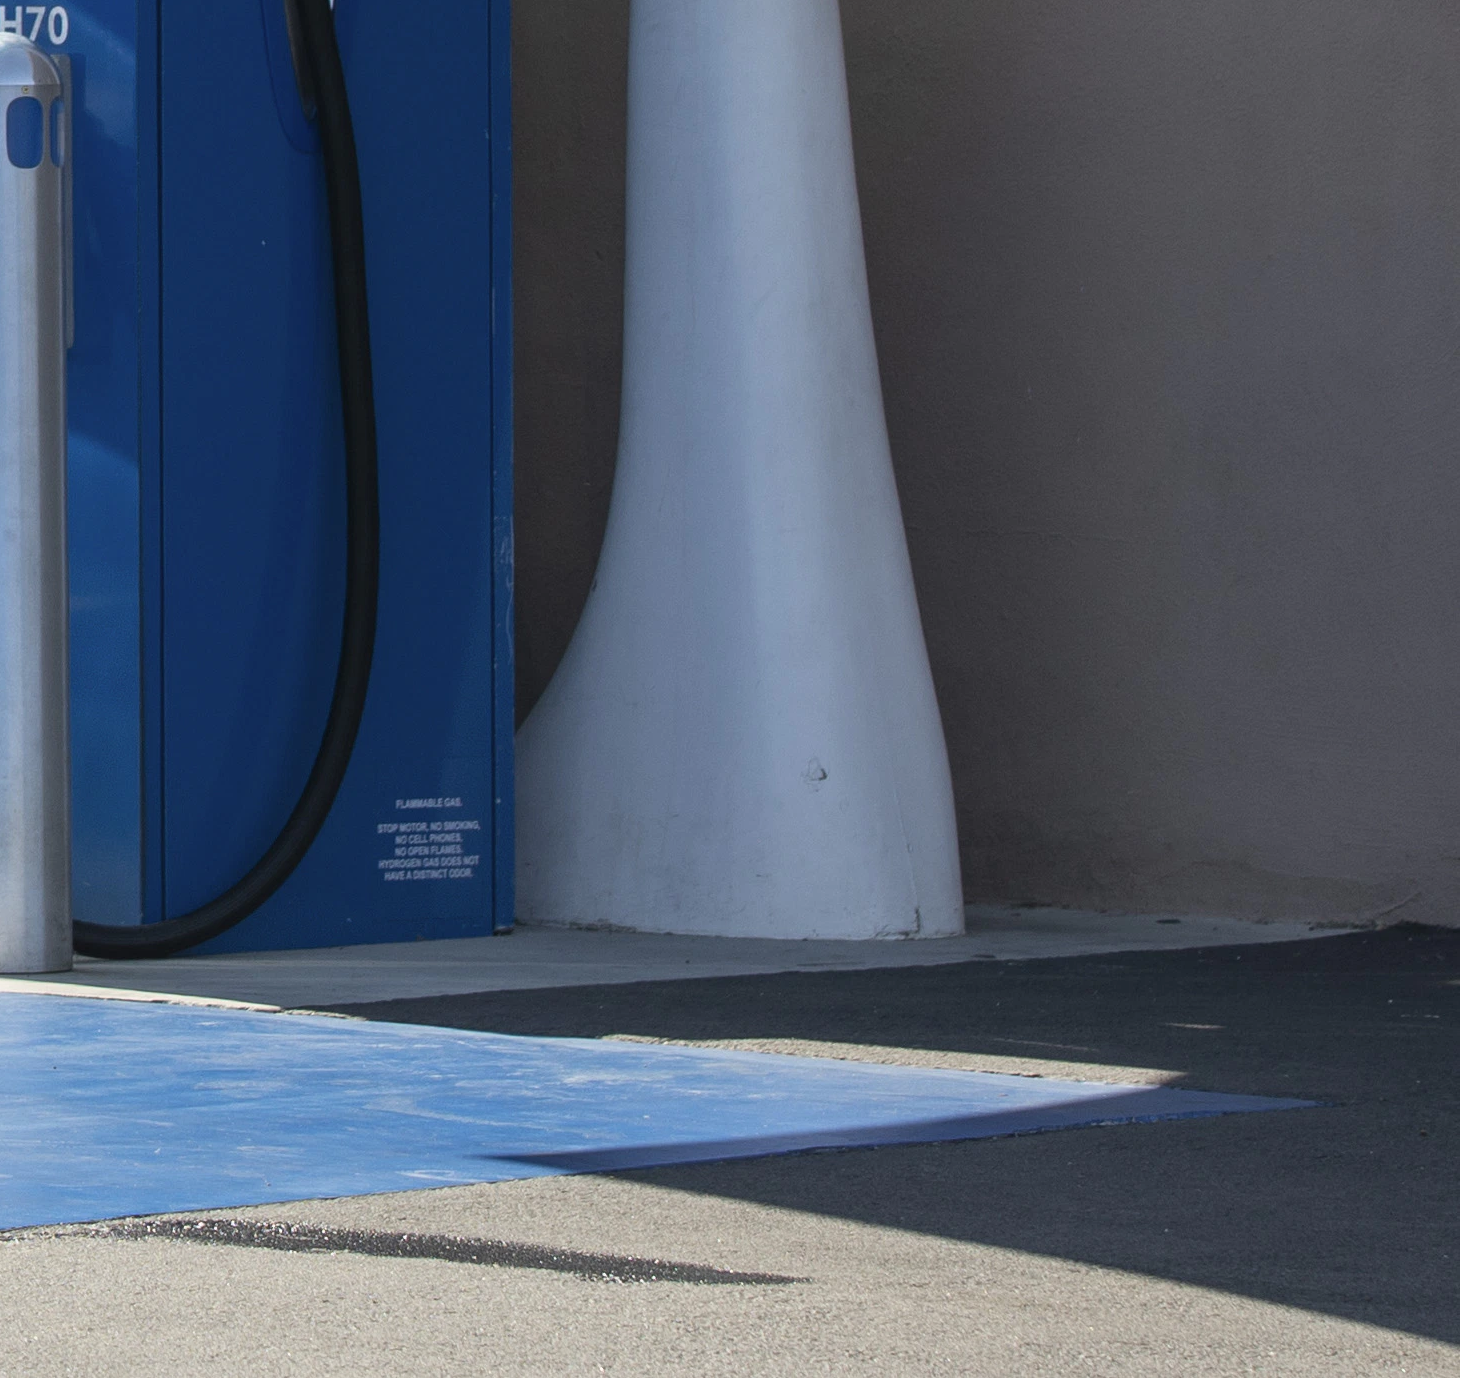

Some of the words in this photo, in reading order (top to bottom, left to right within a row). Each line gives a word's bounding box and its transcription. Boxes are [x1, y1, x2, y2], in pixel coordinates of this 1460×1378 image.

[395, 797, 443, 809] FLAMMABLE
[377, 823, 399, 834] STOP
[429, 821, 443, 831] NO
[395, 835, 408, 845] NO
[408, 834, 429, 844] CELL
[394, 847, 407, 857] NO
[407, 845, 430, 856] OPEN
[378, 857, 422, 869] HYDROGEN
[422, 856, 440, 867] GAS
[440, 856, 462, 866] DOES
[462, 855, 480, 865] NOT
[384, 870, 405, 881] HAVE
[405, 870, 413, 880] A
[412, 868, 448, 880] DISTINCT
